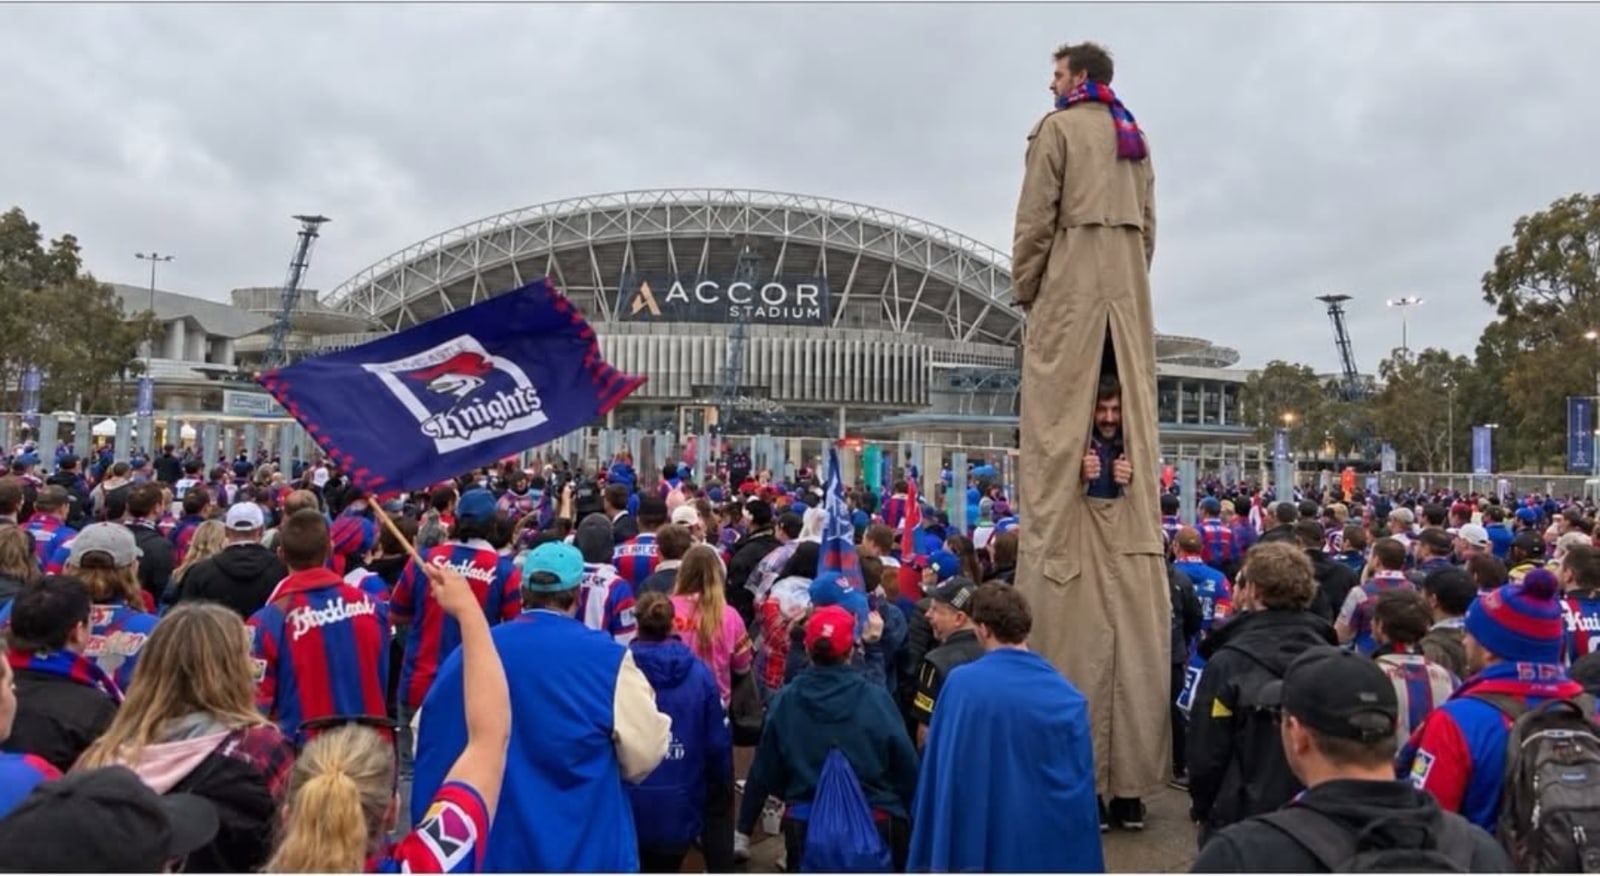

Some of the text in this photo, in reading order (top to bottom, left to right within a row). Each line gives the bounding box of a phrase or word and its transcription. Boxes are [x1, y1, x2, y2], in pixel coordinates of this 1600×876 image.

[665, 281, 819, 306] ACCOR
[729, 306, 820, 319] STADIUM
[386, 340, 465, 371] CASTLE
[420, 387, 542, 441] Knights
[286, 594, 376, 641] Stockland
